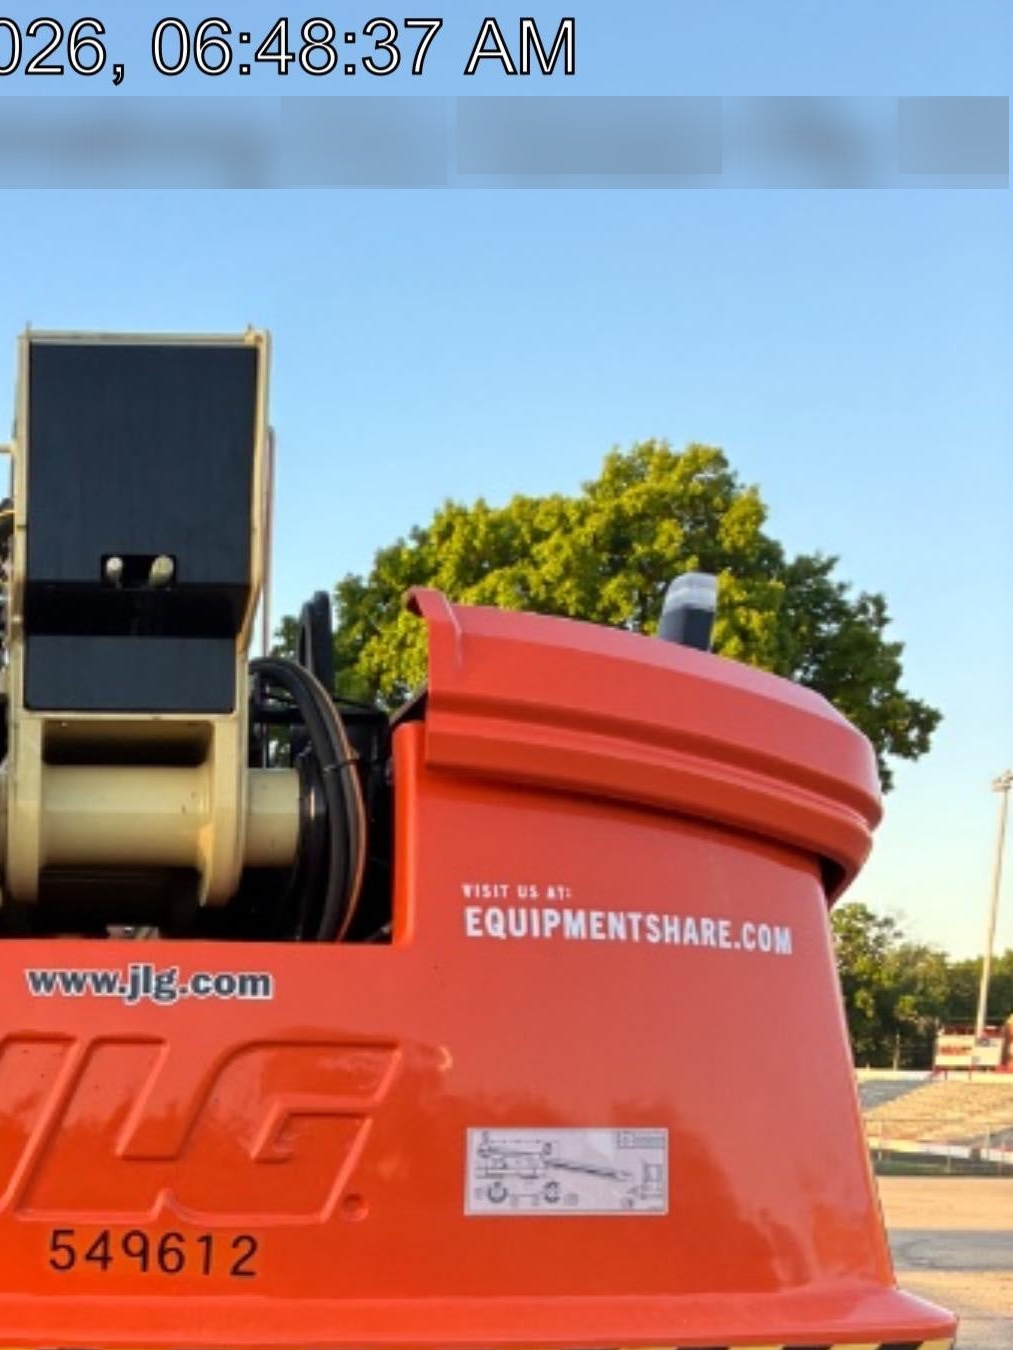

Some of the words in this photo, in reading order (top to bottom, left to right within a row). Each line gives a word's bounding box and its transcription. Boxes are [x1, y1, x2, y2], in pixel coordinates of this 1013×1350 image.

[462, 883, 510, 899] VISIT
[517, 884, 539, 900] US
[546, 886, 572, 901] AT:
[464, 906, 794, 956] EQUIPMENTSHARE.COM
[27, 964, 274, 1003] www.jlg.com
[48, 1230, 258, 1277] 549612
